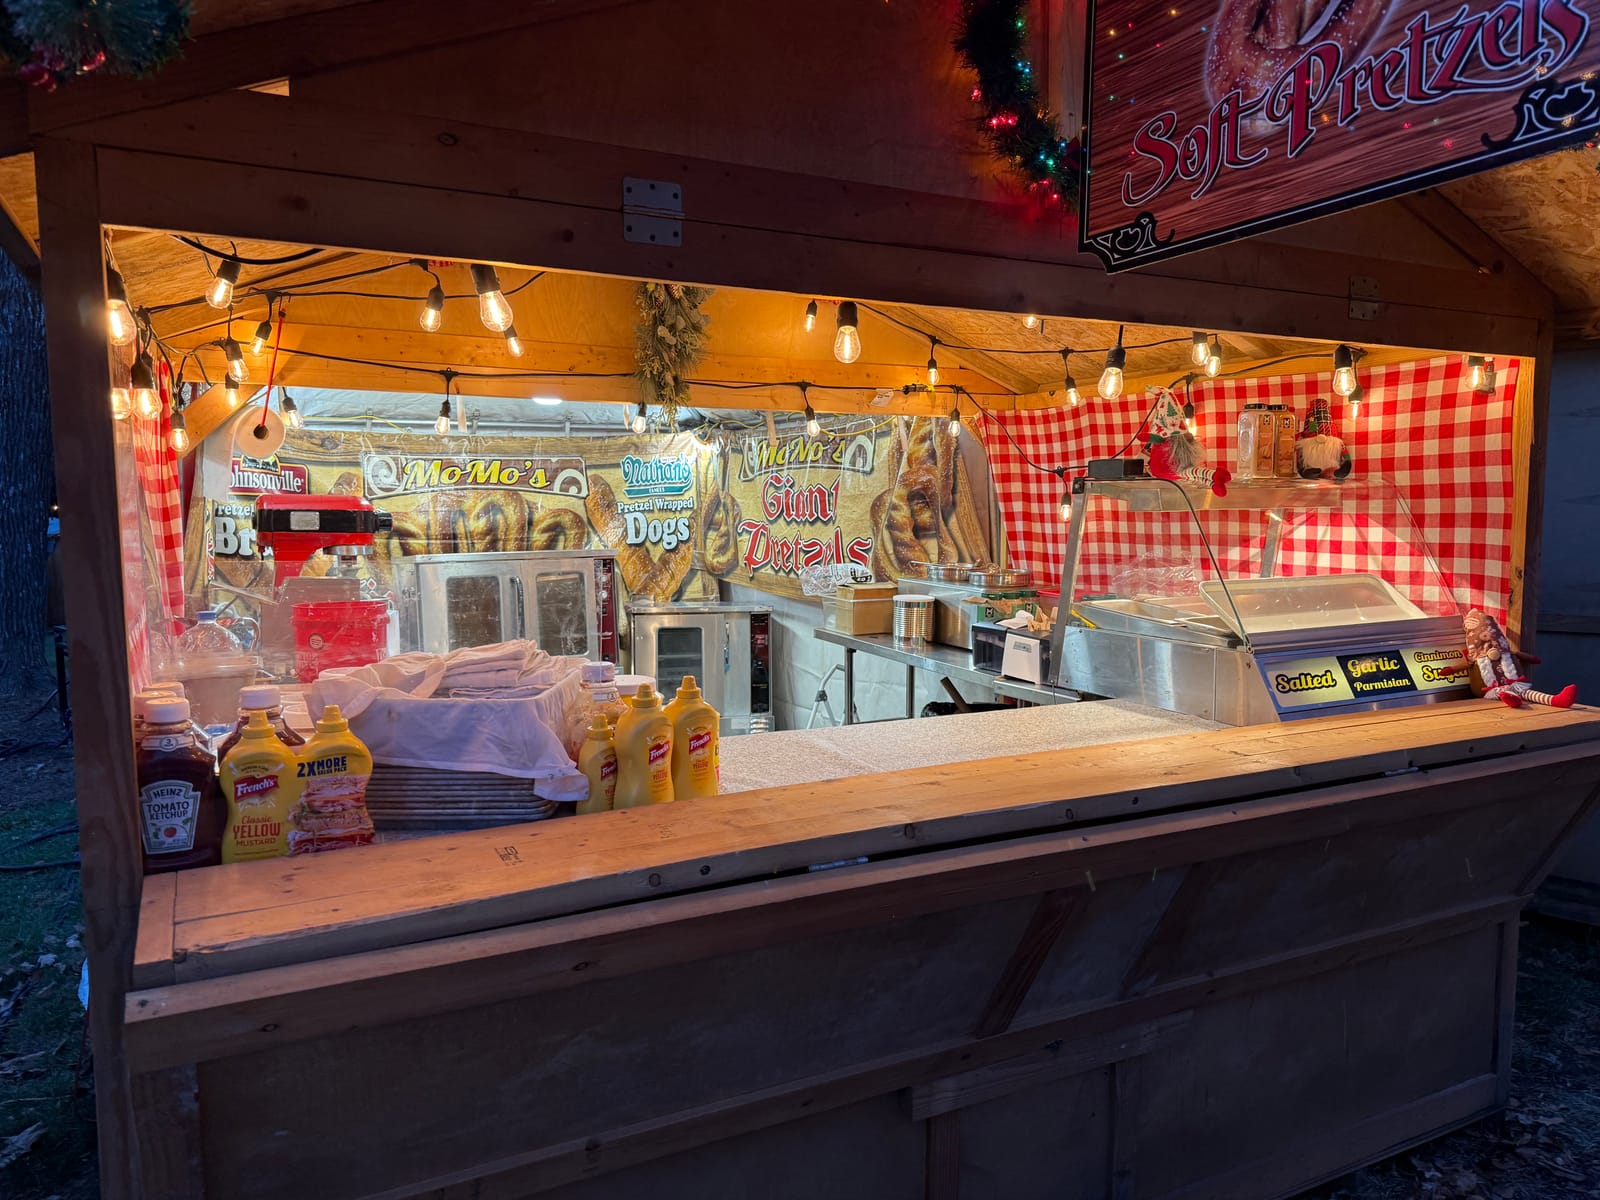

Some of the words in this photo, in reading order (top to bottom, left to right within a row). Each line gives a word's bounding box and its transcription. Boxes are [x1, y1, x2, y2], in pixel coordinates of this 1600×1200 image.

[1121, 87, 1270, 207] Soft
[1265, 0, 1590, 158] Pretzels
[231, 463, 303, 493] ohnsonville
[403, 459, 551, 490] MoMo's
[214, 502, 255, 517] retzel
[617, 499, 653, 513] Pretzel
[654, 496, 694, 512] Wrapped
[624, 511, 691, 550] Dogs
[1347, 657, 1401, 678] Garlic
[1276, 670, 1337, 693] Salted
[297, 762, 316, 778] 2X
[317, 756, 347, 770] MORE
[152, 788, 183, 799] HEINZ
[236, 778, 275, 797] French's
[147, 801, 190, 813] TOMATO
[150, 809, 188, 820] KETCHUP
[233, 822, 281, 840] YELLOW
